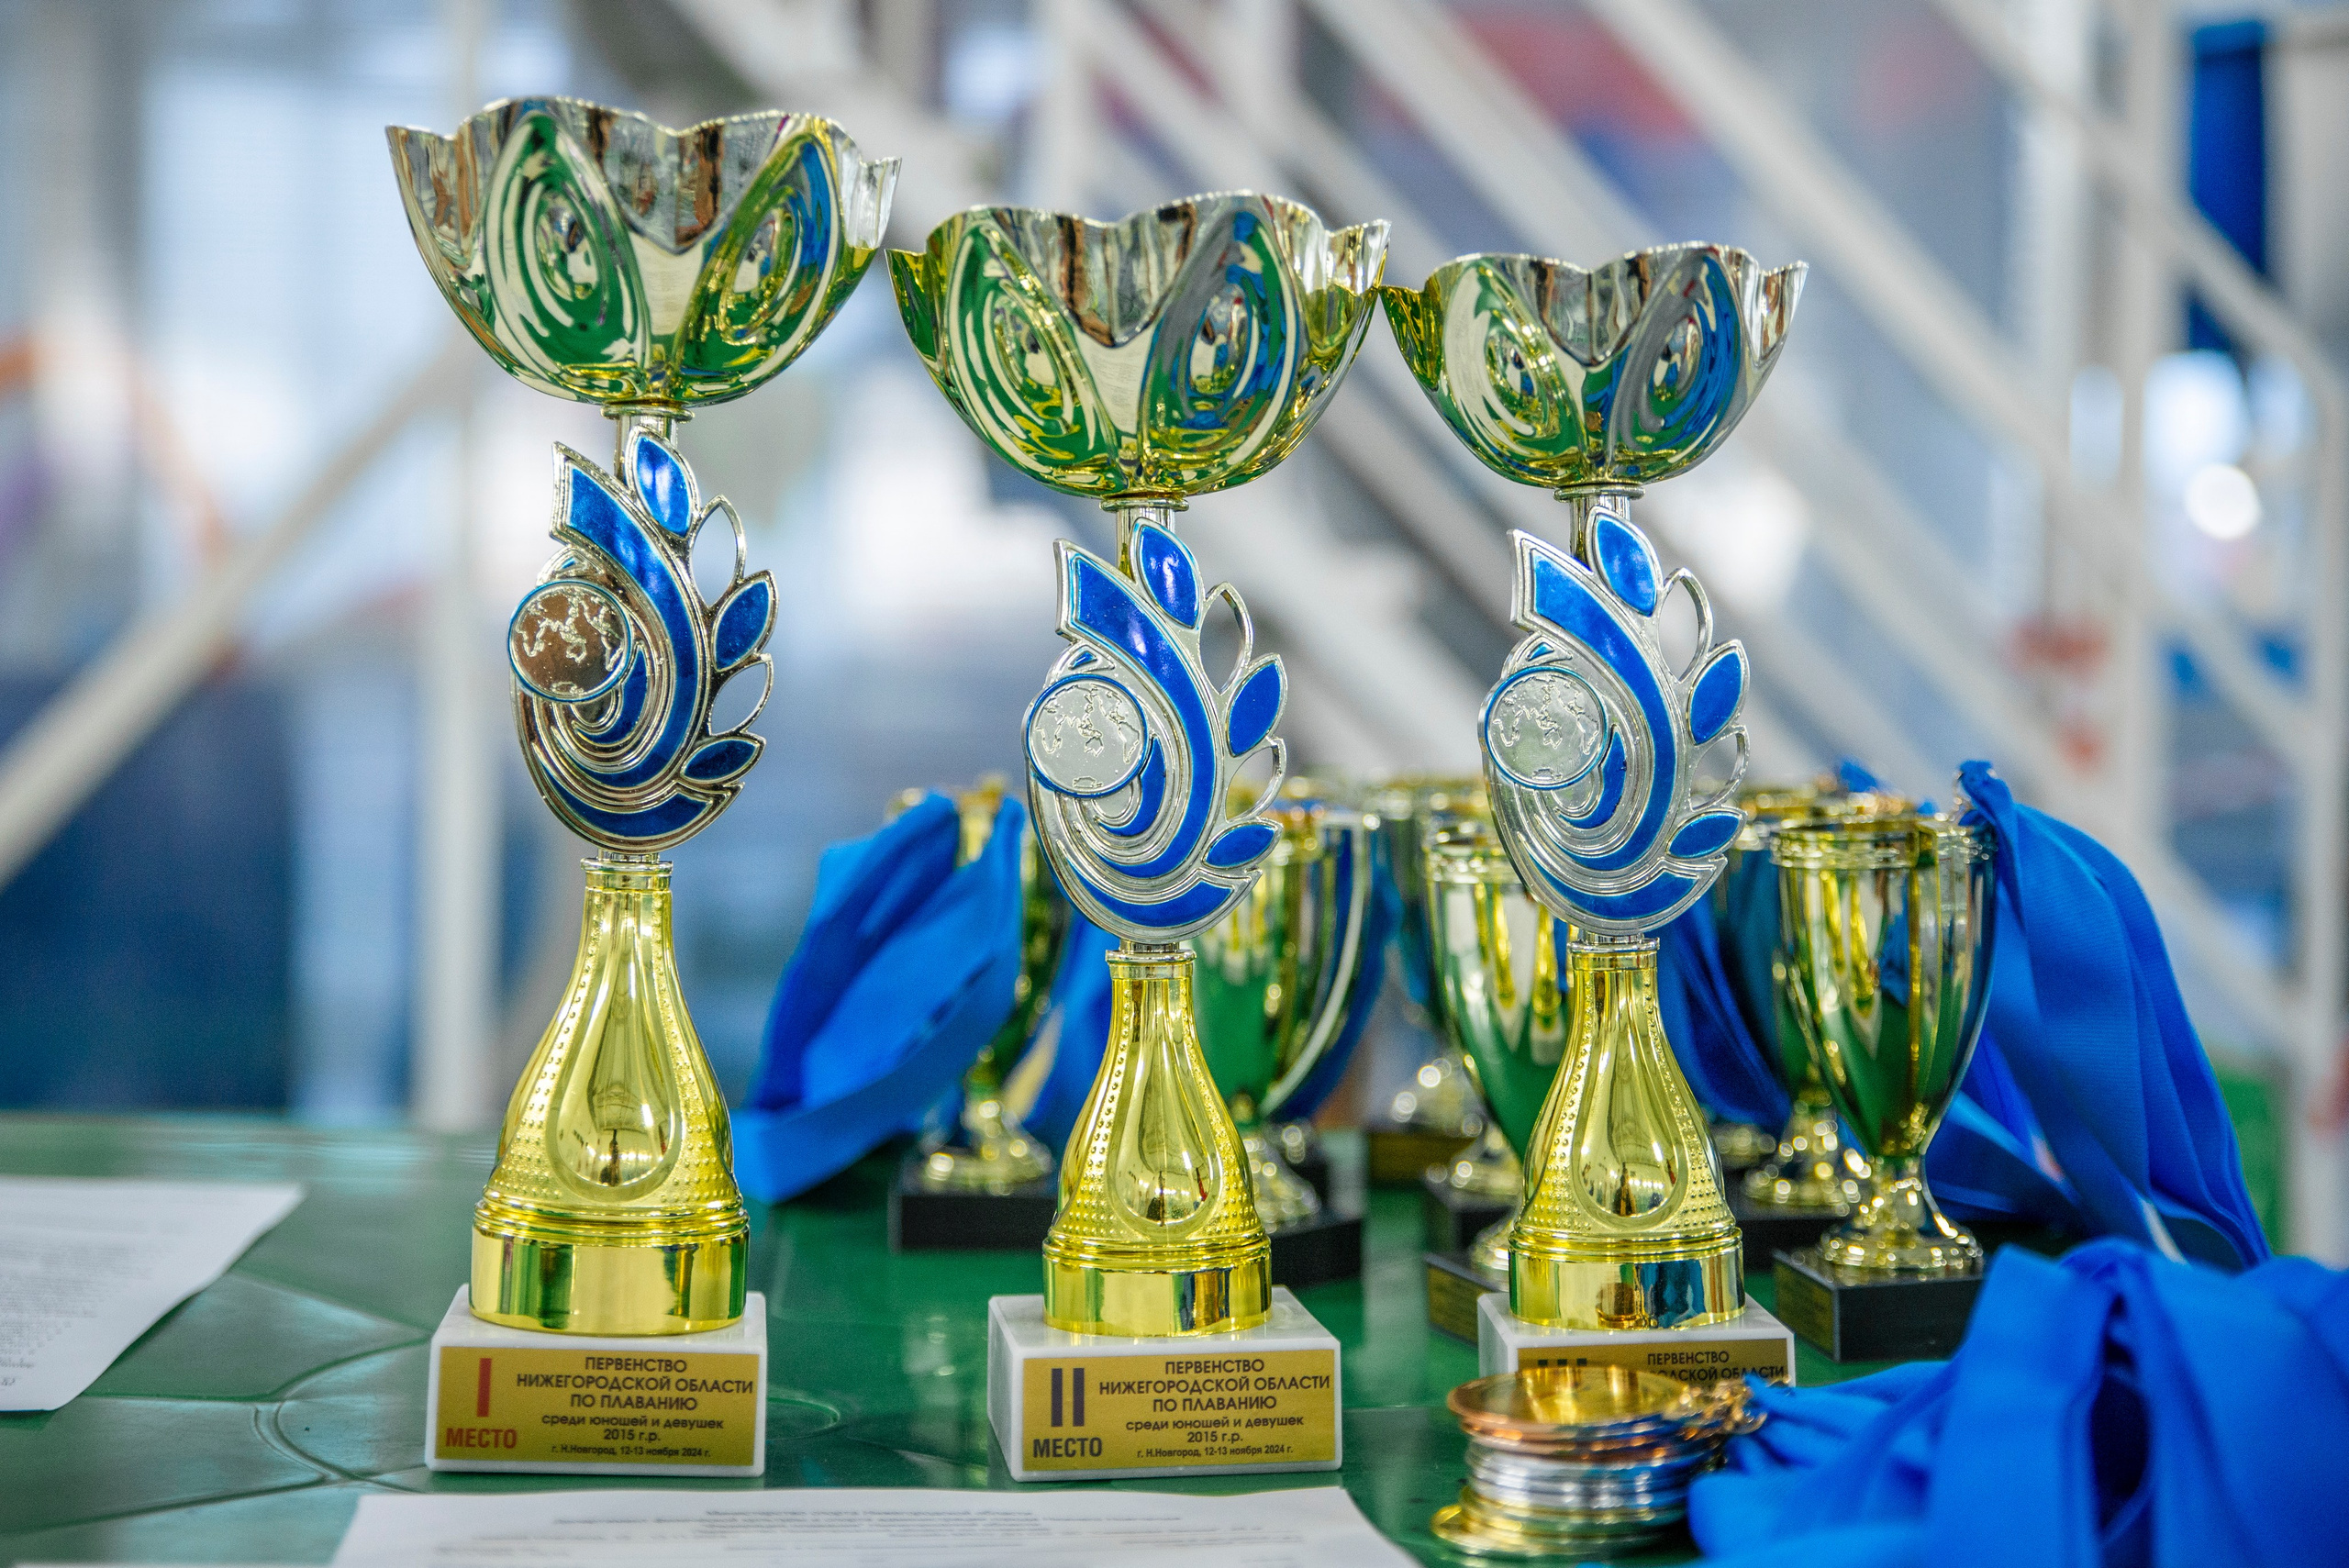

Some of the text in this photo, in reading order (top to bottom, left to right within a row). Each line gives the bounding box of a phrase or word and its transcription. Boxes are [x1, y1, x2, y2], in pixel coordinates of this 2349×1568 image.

[585, 1357, 687, 1373] ПЕРВЕНСТВО
[1647, 1351, 1730, 1365] ПЕРВЕНСТВО
[1165, 1359, 1264, 1374] ПЕРВЕНСТВО
[517, 1373, 753, 1394] НИЖЕГОРОДСКОЙ ОБЛАСТИ
[1099, 1375, 1330, 1395] НИЖЕГОРОДСКОЙ ОБЛАСТИ
[571, 1394, 697, 1410] ПО ПЛАВАНИЮ
[1152, 1396, 1276, 1412] ПО ПЛАВАНИЮ
[541, 1415, 724, 1430] среди юношей и девушек
[1126, 1417, 1304, 1432] среди юношей и девушек
[445, 1428, 518, 1449] МЕСТО
[604, 1429, 661, 1443] 2015 г.р.
[1187, 1431, 1243, 1444] 2015 г.р.
[620, 1447, 644, 1455] 12-13
[646, 1447, 679, 1457] ноября
[682, 1448, 702, 1456] 2024
[1033, 1437, 1103, 1458] МЕСТО
[1146, 1448, 1201, 1458] Н.Новгород,
[1205, 1447, 1228, 1456] 12-13
[1230, 1446, 1262, 1456] ноября
[1264, 1444, 1285, 1453] 2024
